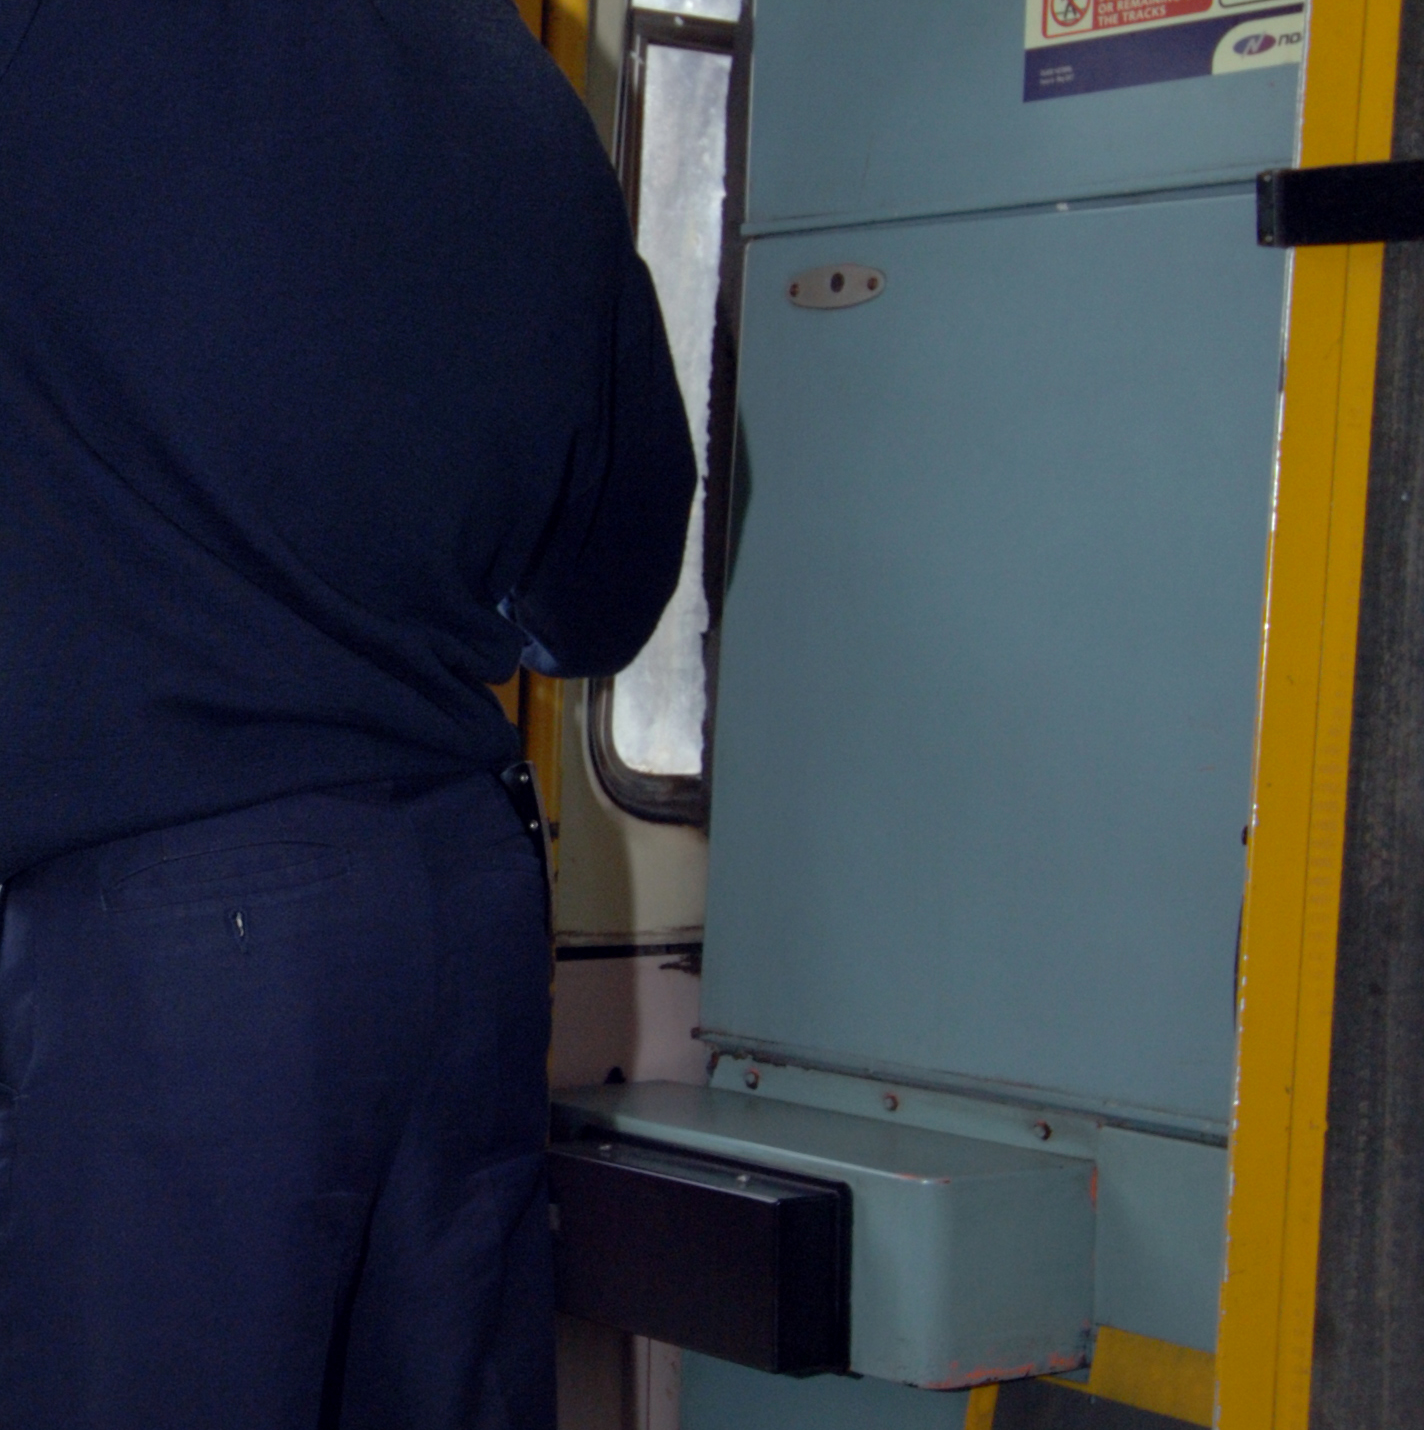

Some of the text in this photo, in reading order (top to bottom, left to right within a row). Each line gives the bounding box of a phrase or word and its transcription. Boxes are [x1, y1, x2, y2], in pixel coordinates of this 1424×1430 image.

[1098, 2, 1113, 13] OR
[1097, 5, 1166, 26] THE TRACKS
[1278, 32, 1301, 46] no
